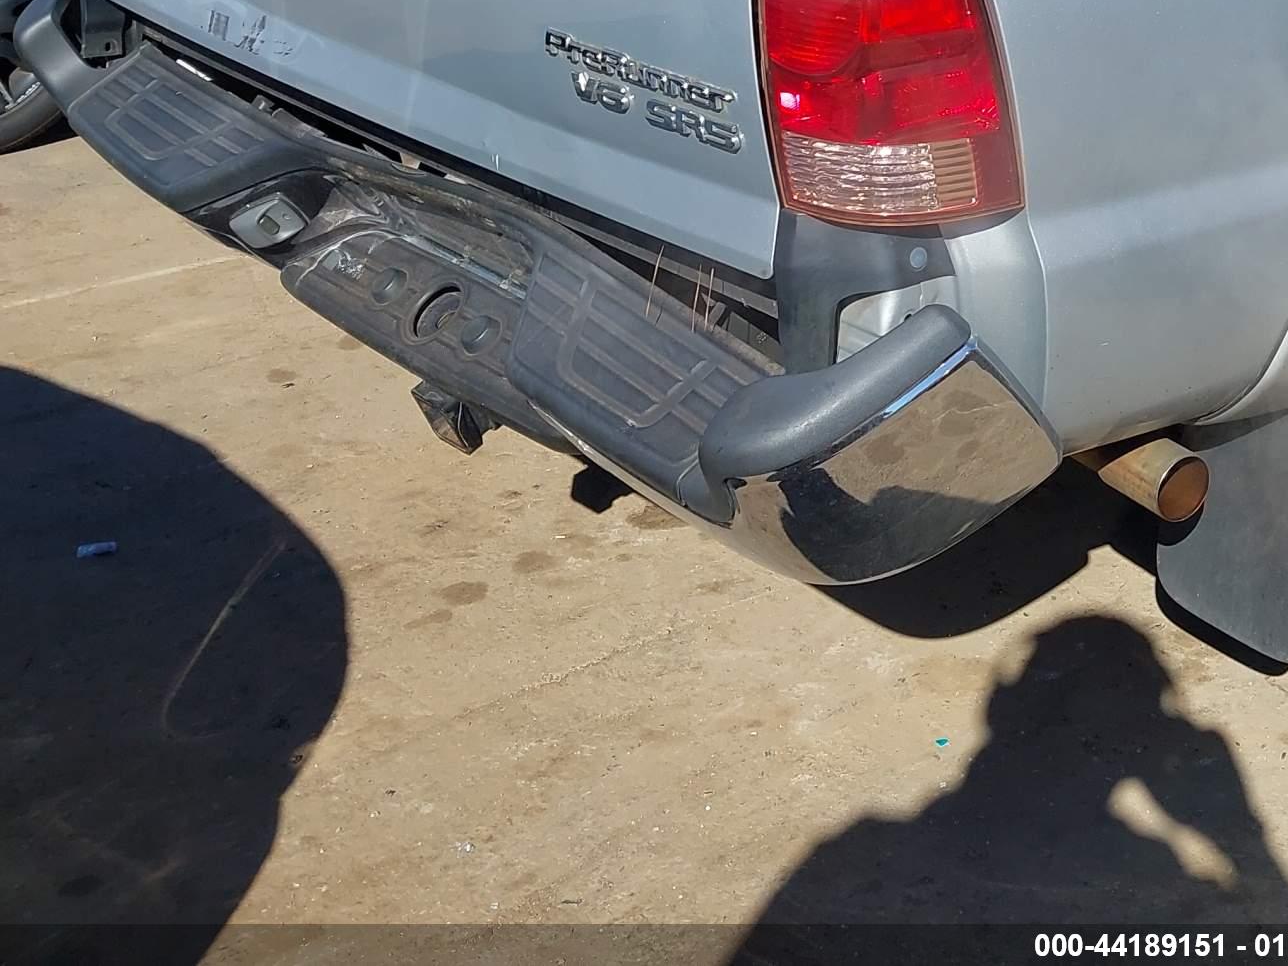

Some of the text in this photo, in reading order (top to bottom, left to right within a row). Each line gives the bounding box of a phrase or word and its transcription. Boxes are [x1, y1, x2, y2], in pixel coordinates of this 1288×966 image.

[545, 26, 737, 113] PreRunner
[571, 71, 744, 155] V6 SR5
